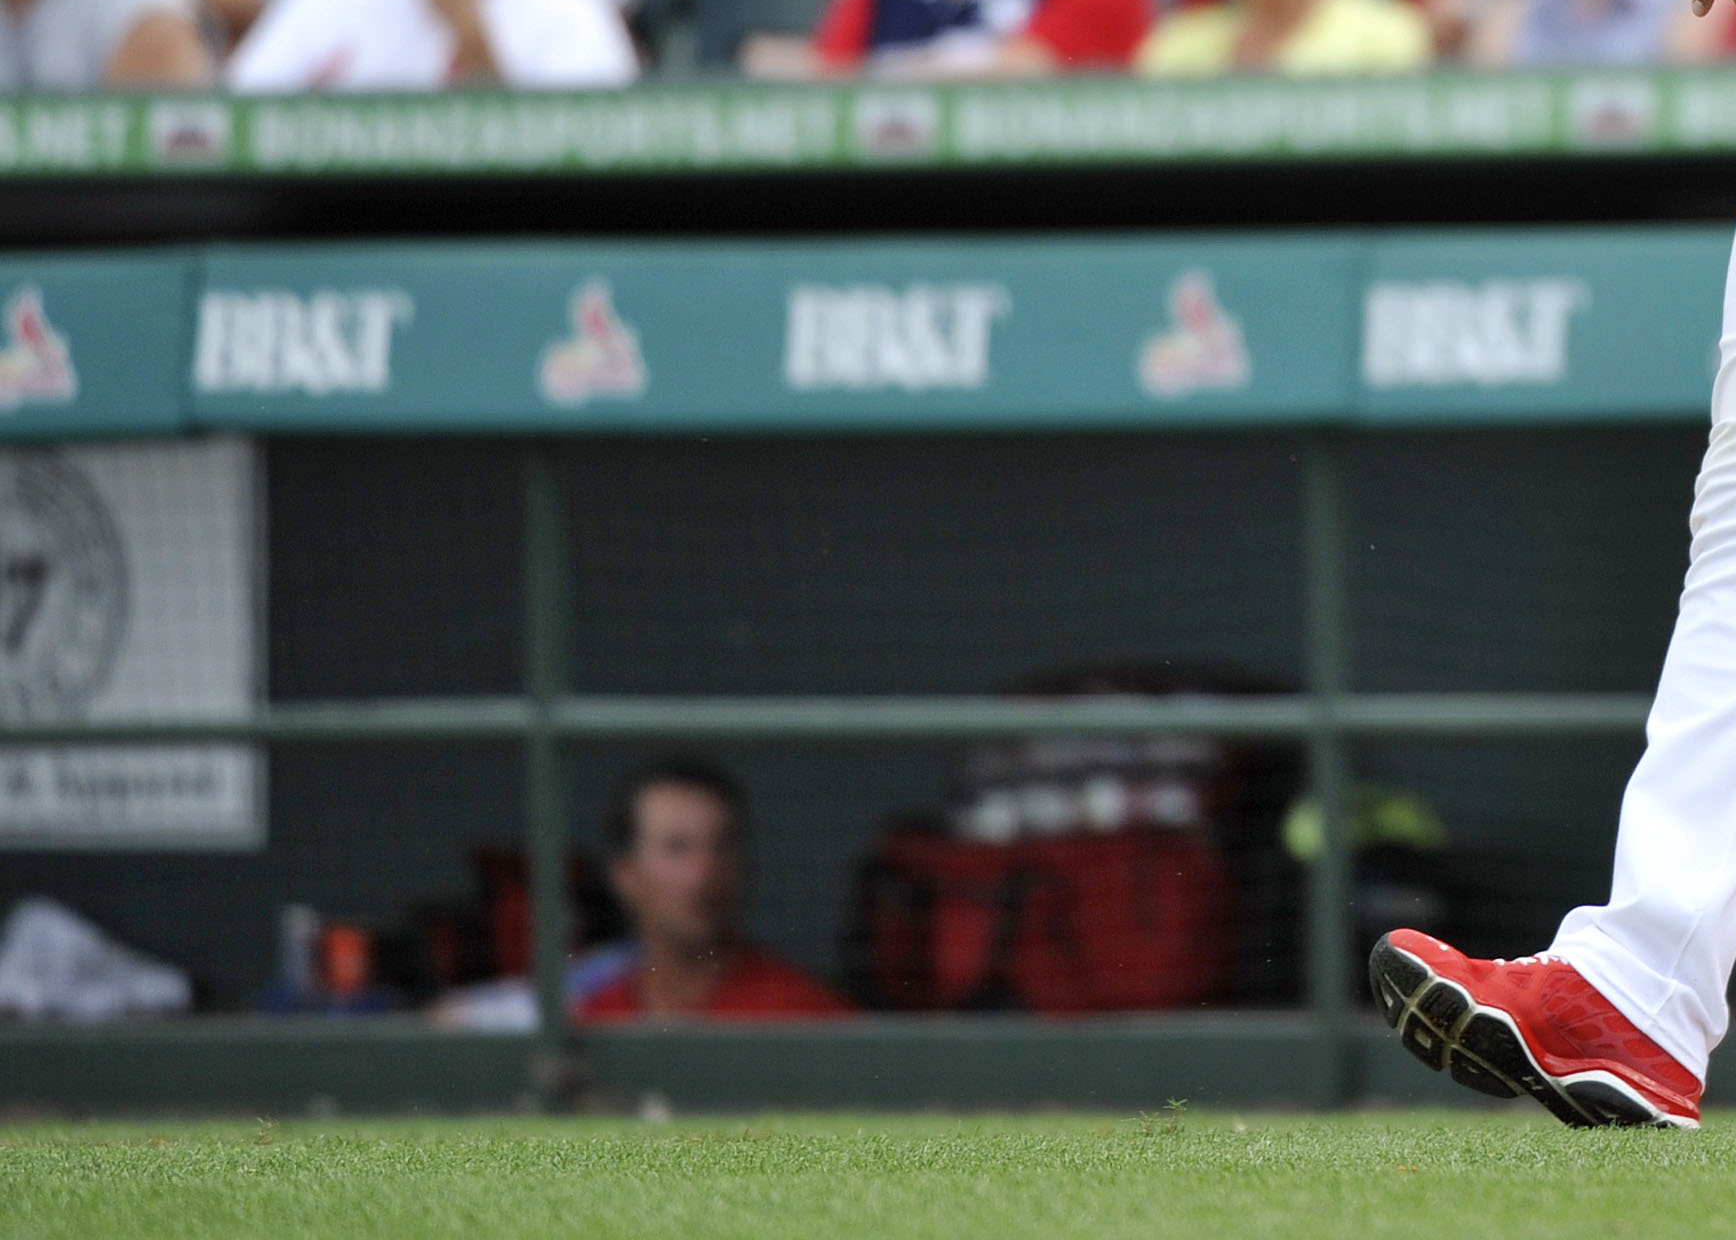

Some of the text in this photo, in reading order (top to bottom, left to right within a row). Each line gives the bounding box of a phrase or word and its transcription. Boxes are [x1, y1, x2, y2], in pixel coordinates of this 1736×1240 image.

[195, 290, 410, 392] BB&T
[786, 284, 1007, 390] BB&T
[1363, 279, 1586, 387] BB&T
